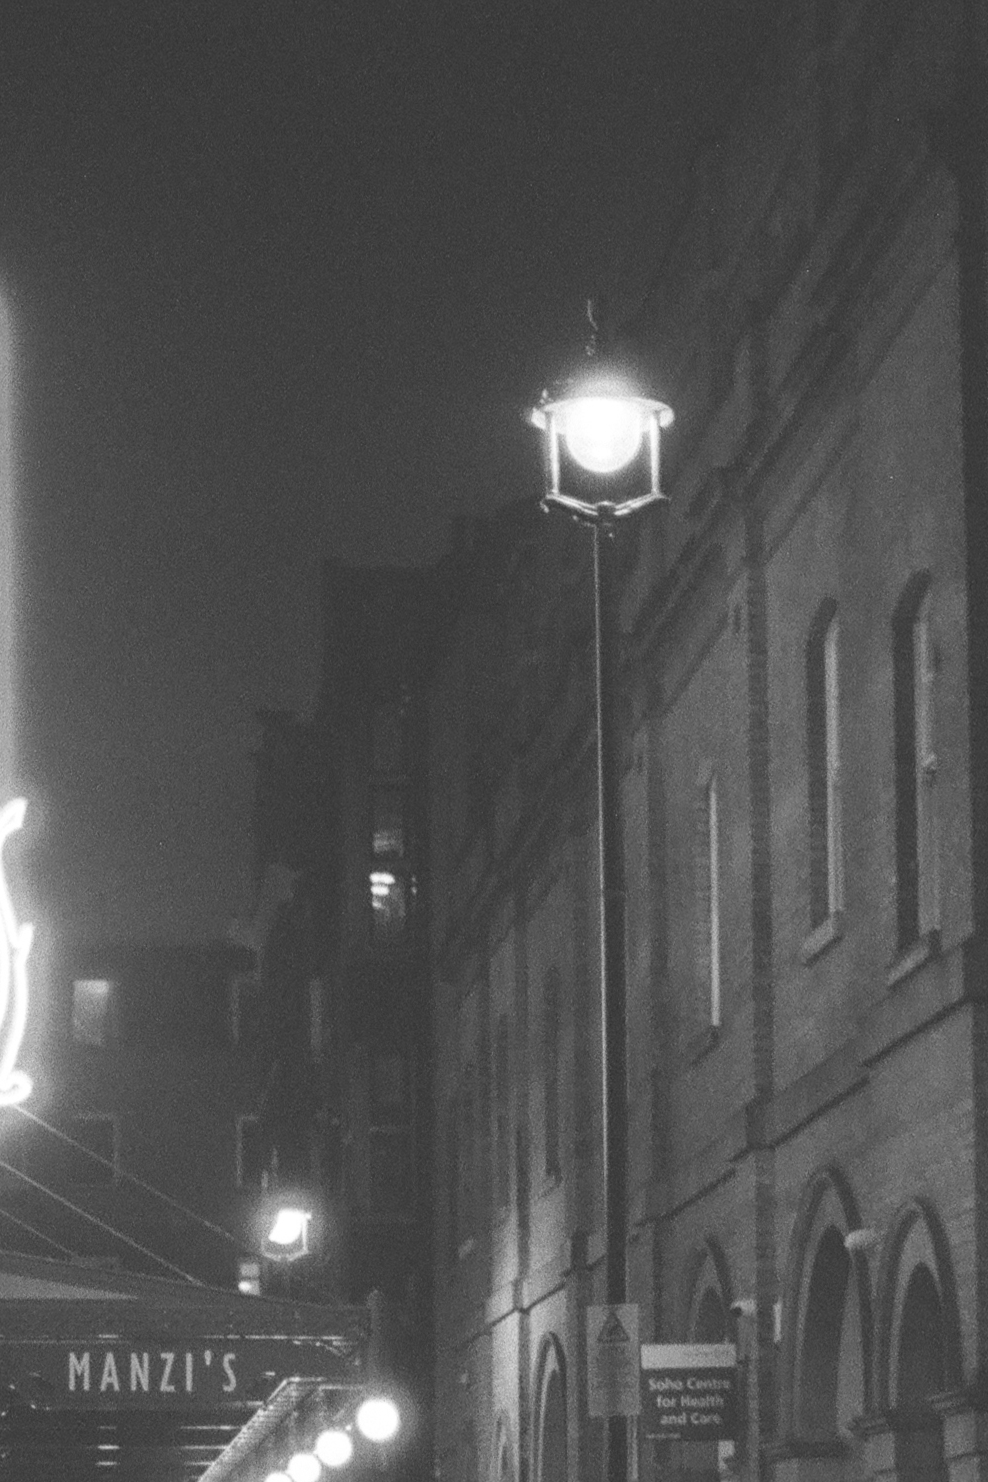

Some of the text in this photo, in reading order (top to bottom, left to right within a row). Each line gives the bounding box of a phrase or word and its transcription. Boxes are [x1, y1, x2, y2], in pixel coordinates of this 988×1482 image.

[68, 1350, 238, 1393] MANZI'S
[648, 1377, 731, 1392] Soho Centre
[656, 1394, 725, 1408] for Health
[660, 1412, 687, 1426] and
